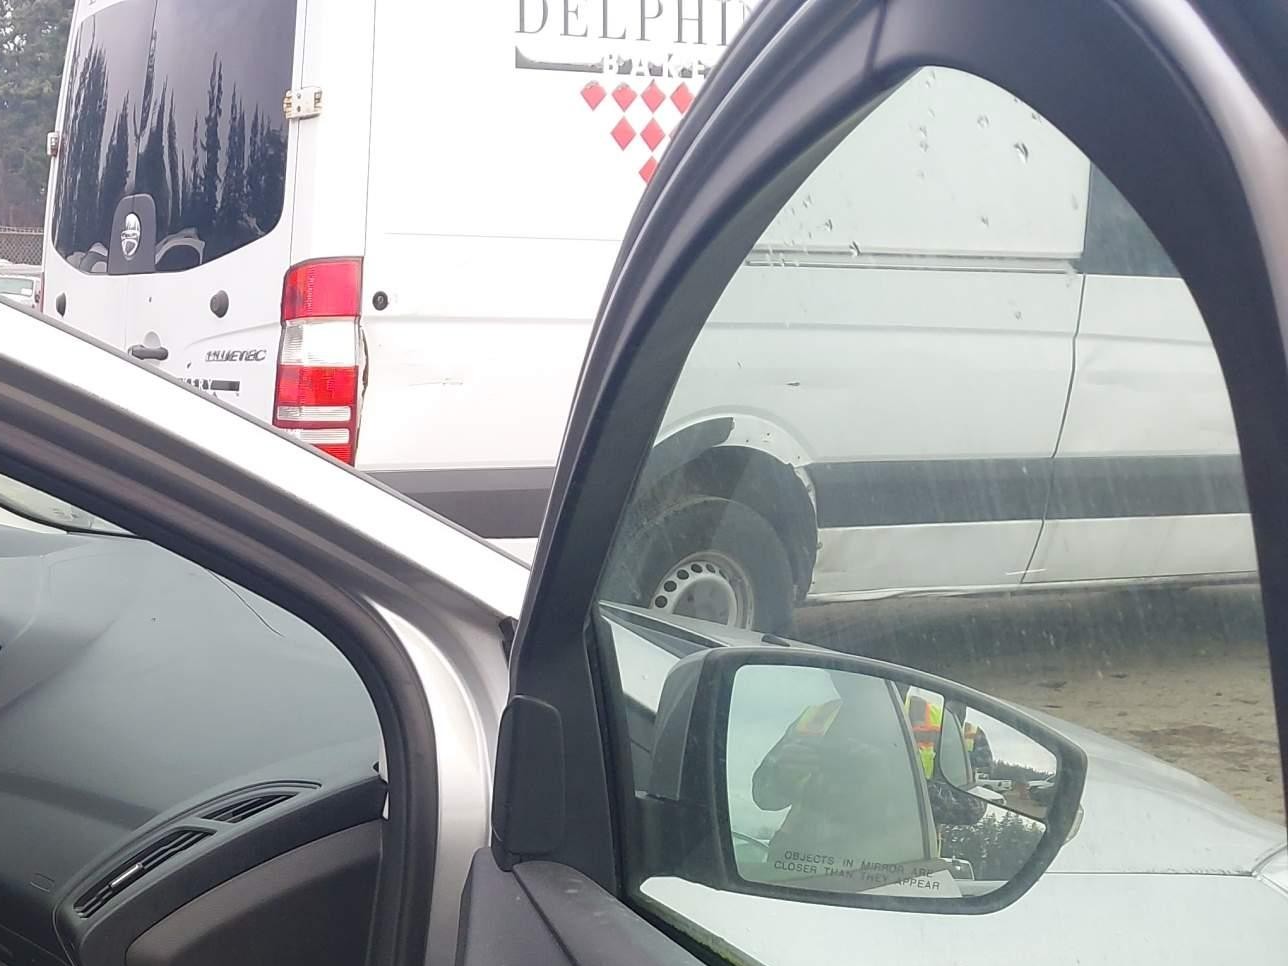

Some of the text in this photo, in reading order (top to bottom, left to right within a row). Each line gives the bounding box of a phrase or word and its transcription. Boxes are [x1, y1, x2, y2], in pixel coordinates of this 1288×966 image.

[774, 860, 940, 890] CLOSER THAN THEY APPEAR
[784, 850, 935, 878] OBJECTS IN MIRROR ARE
